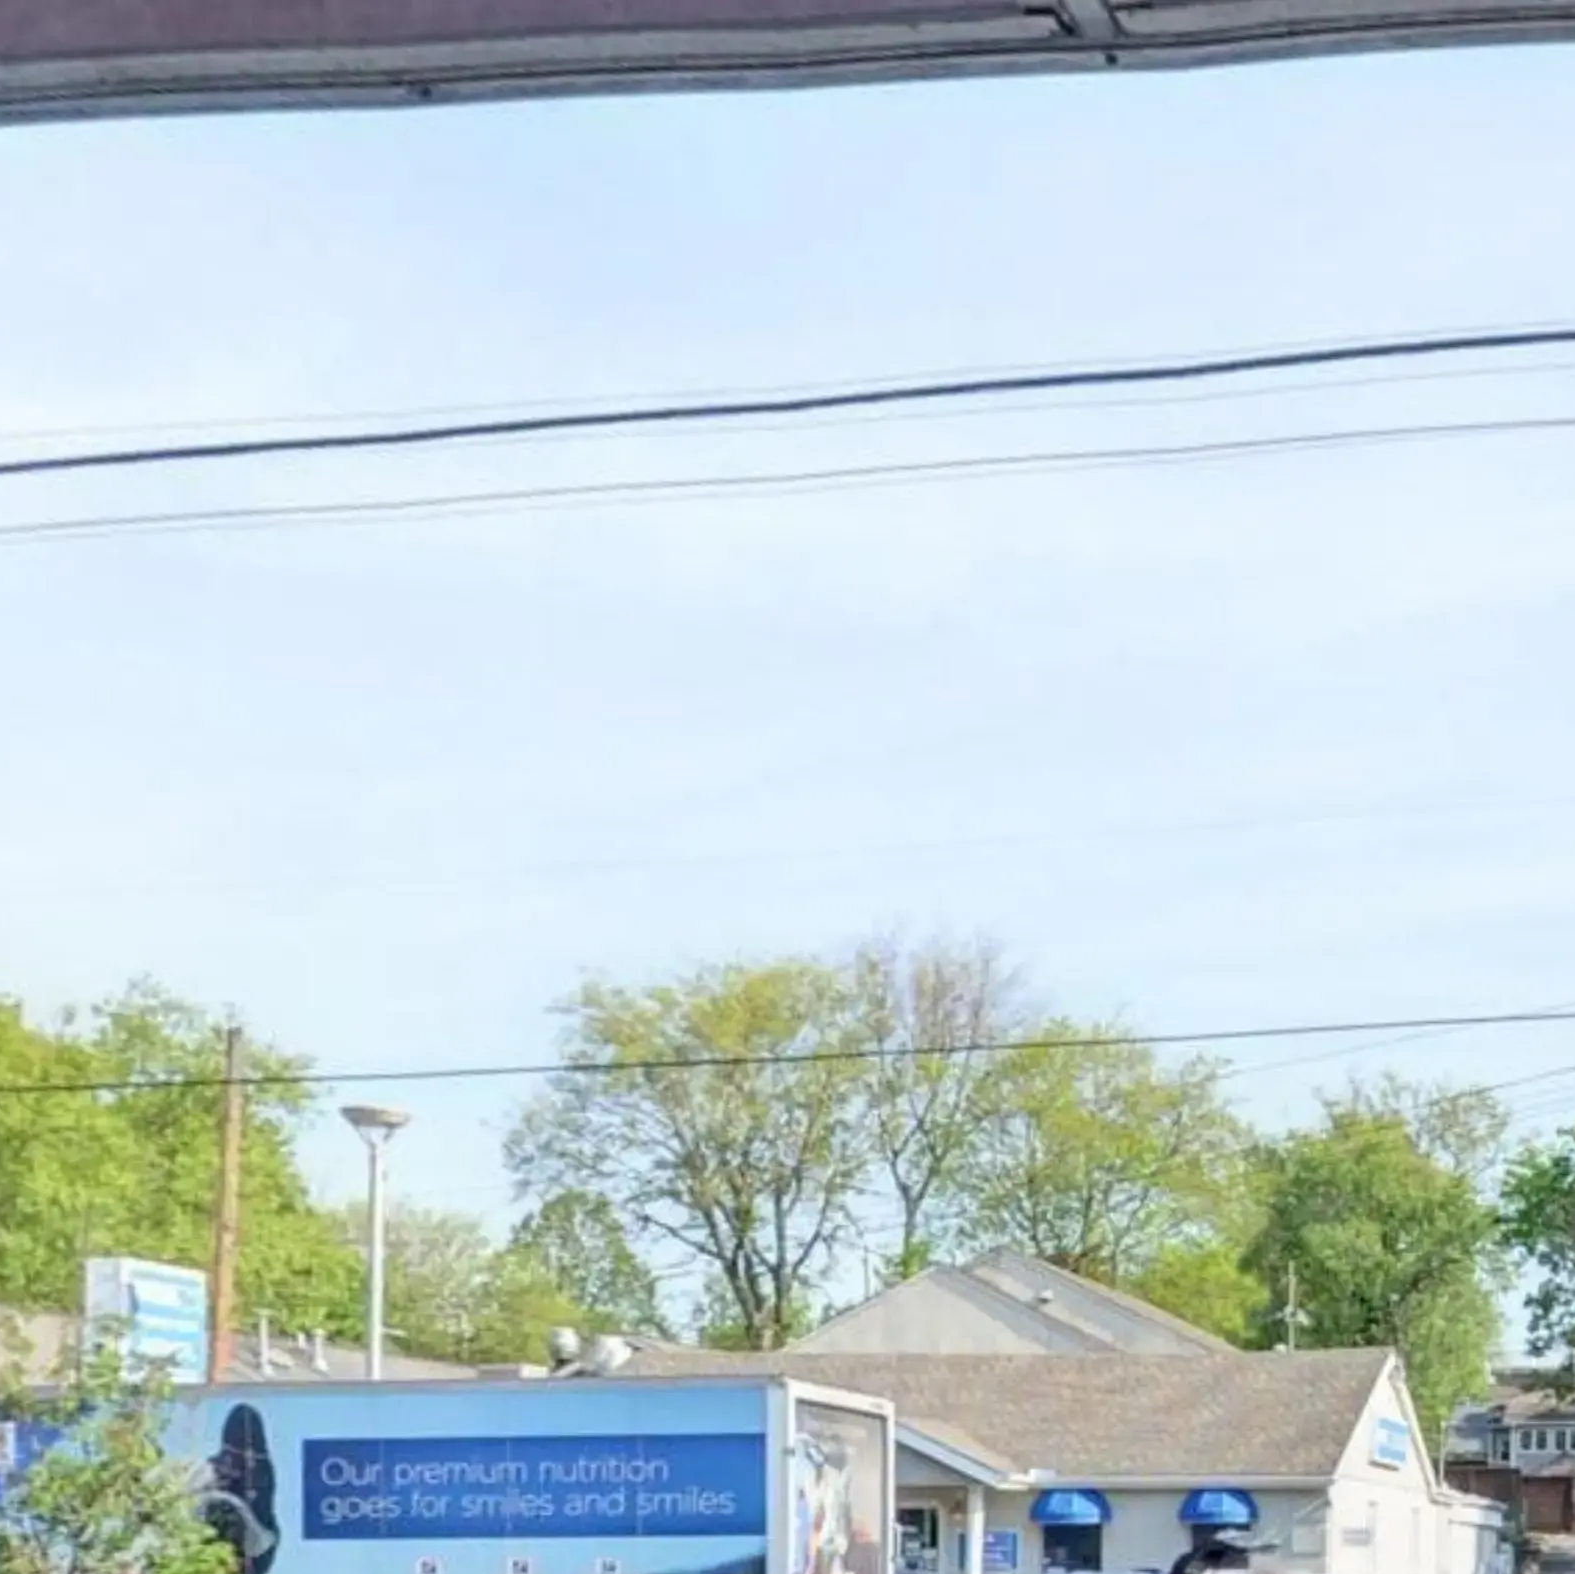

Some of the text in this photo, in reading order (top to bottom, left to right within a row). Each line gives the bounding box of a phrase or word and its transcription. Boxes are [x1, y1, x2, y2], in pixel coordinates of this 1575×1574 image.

[321, 1454, 670, 1492] Our premium nutrition
[320, 1485, 737, 1525] goes for smiles and smiles
